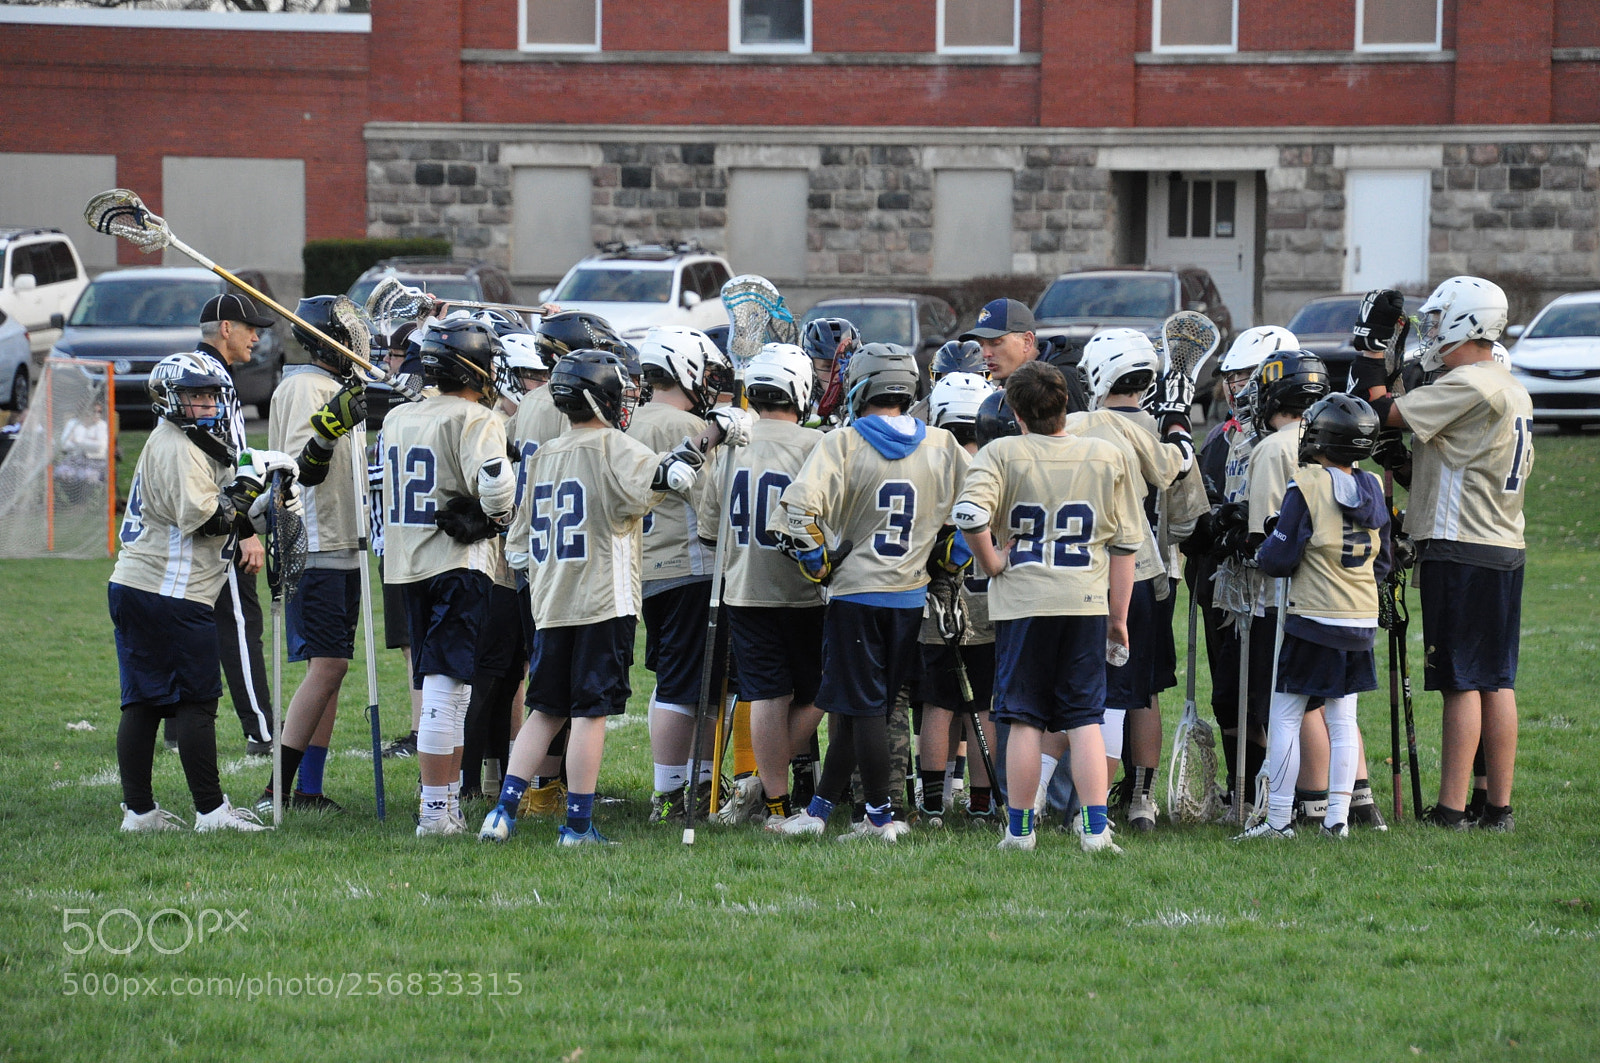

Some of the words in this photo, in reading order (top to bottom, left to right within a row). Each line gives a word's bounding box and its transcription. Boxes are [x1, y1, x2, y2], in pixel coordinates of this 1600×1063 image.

[1158, 402, 1187, 413] STX
[387, 444, 438, 527] 12
[529, 477, 588, 564] 52
[729, 467, 793, 549] 40
[870, 479, 917, 561] 3
[955, 512, 976, 521] STX
[1008, 500, 1097, 571] 22
